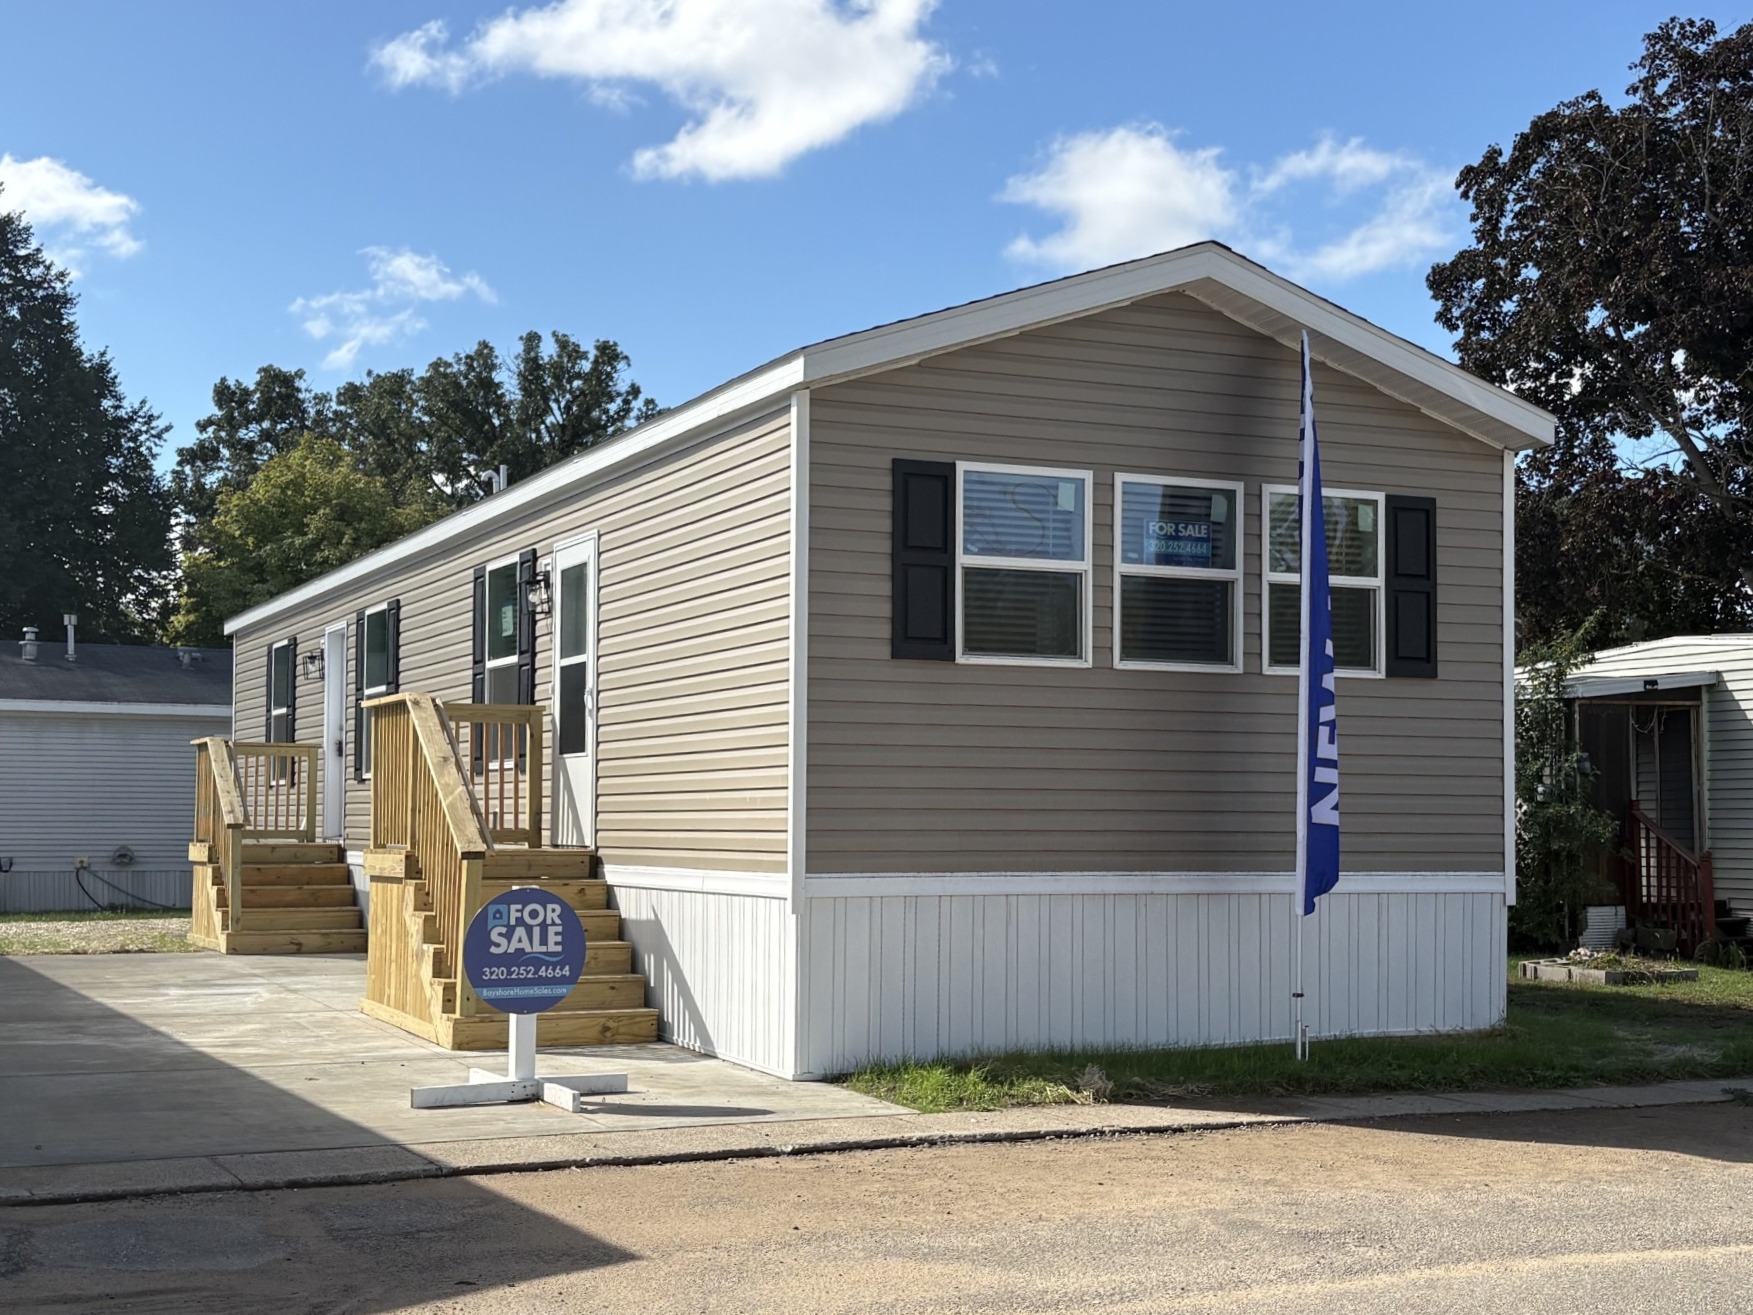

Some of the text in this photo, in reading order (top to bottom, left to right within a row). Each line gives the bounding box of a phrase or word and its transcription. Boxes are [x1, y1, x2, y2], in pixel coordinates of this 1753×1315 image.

[1149, 521, 1208, 538] FOR SALE
[509, 903, 562, 926] FOR
[489, 926, 563, 954] SALE
[482, 965, 570, 980] 320.252.4664
[483, 985, 567, 997] BayshoreHomeSales.com
